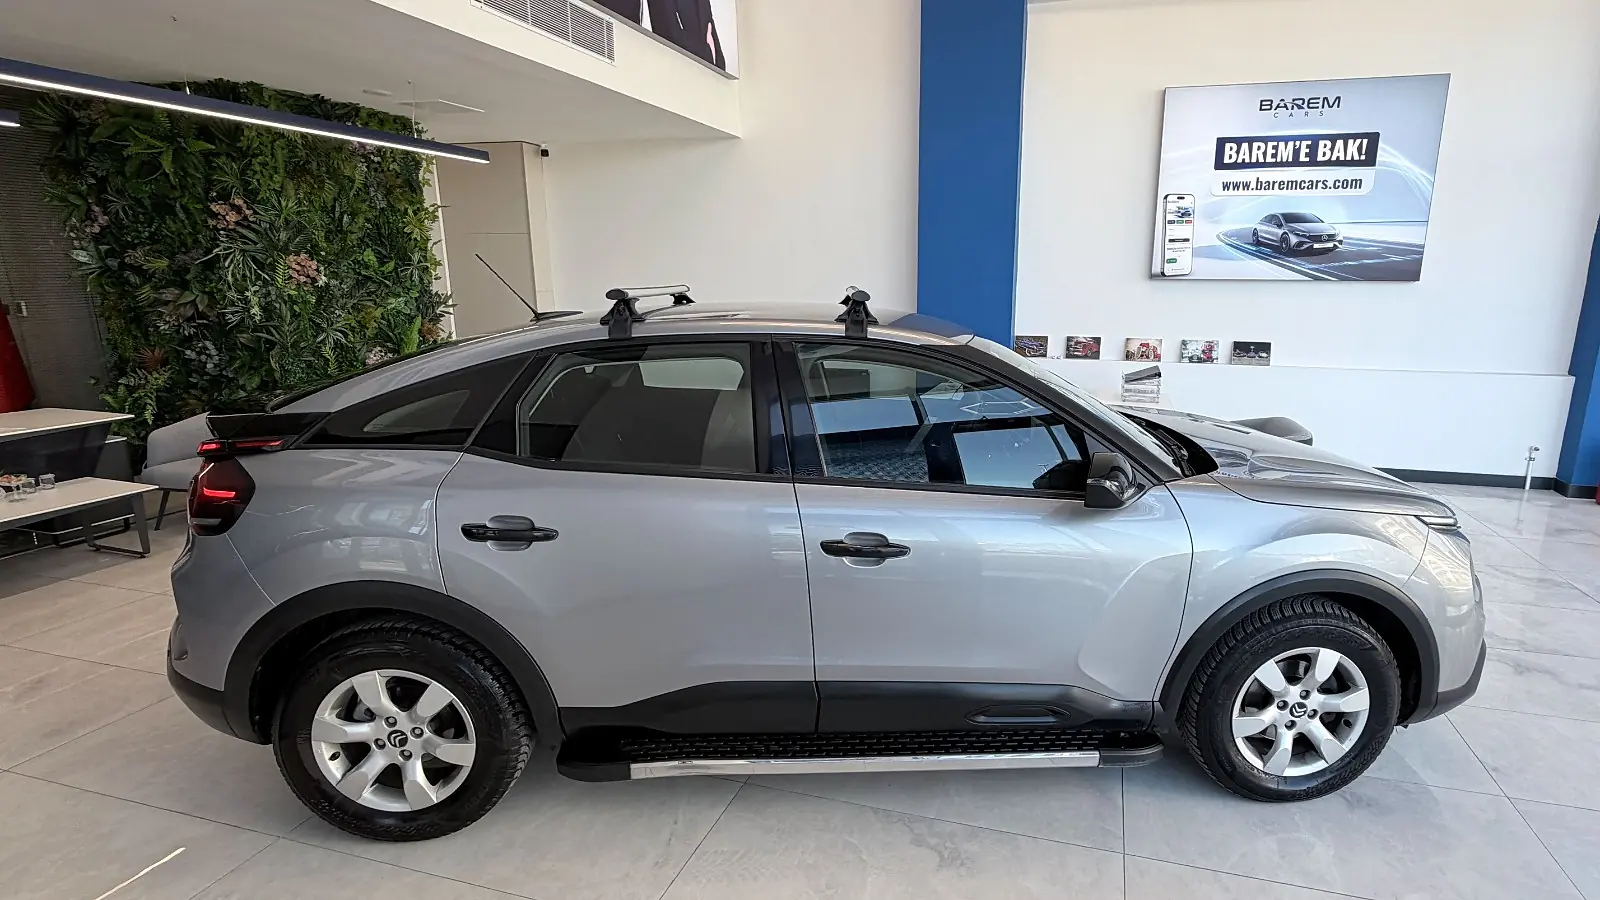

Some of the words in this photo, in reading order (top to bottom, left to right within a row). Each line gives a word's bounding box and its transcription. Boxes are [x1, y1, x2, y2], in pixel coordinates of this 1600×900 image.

[1259, 96, 1341, 111] BAREM
[1273, 110, 1324, 118] CARS
[1317, 138, 1368, 161] BAK!
[1222, 177, 1363, 192] www.baremcars.com
